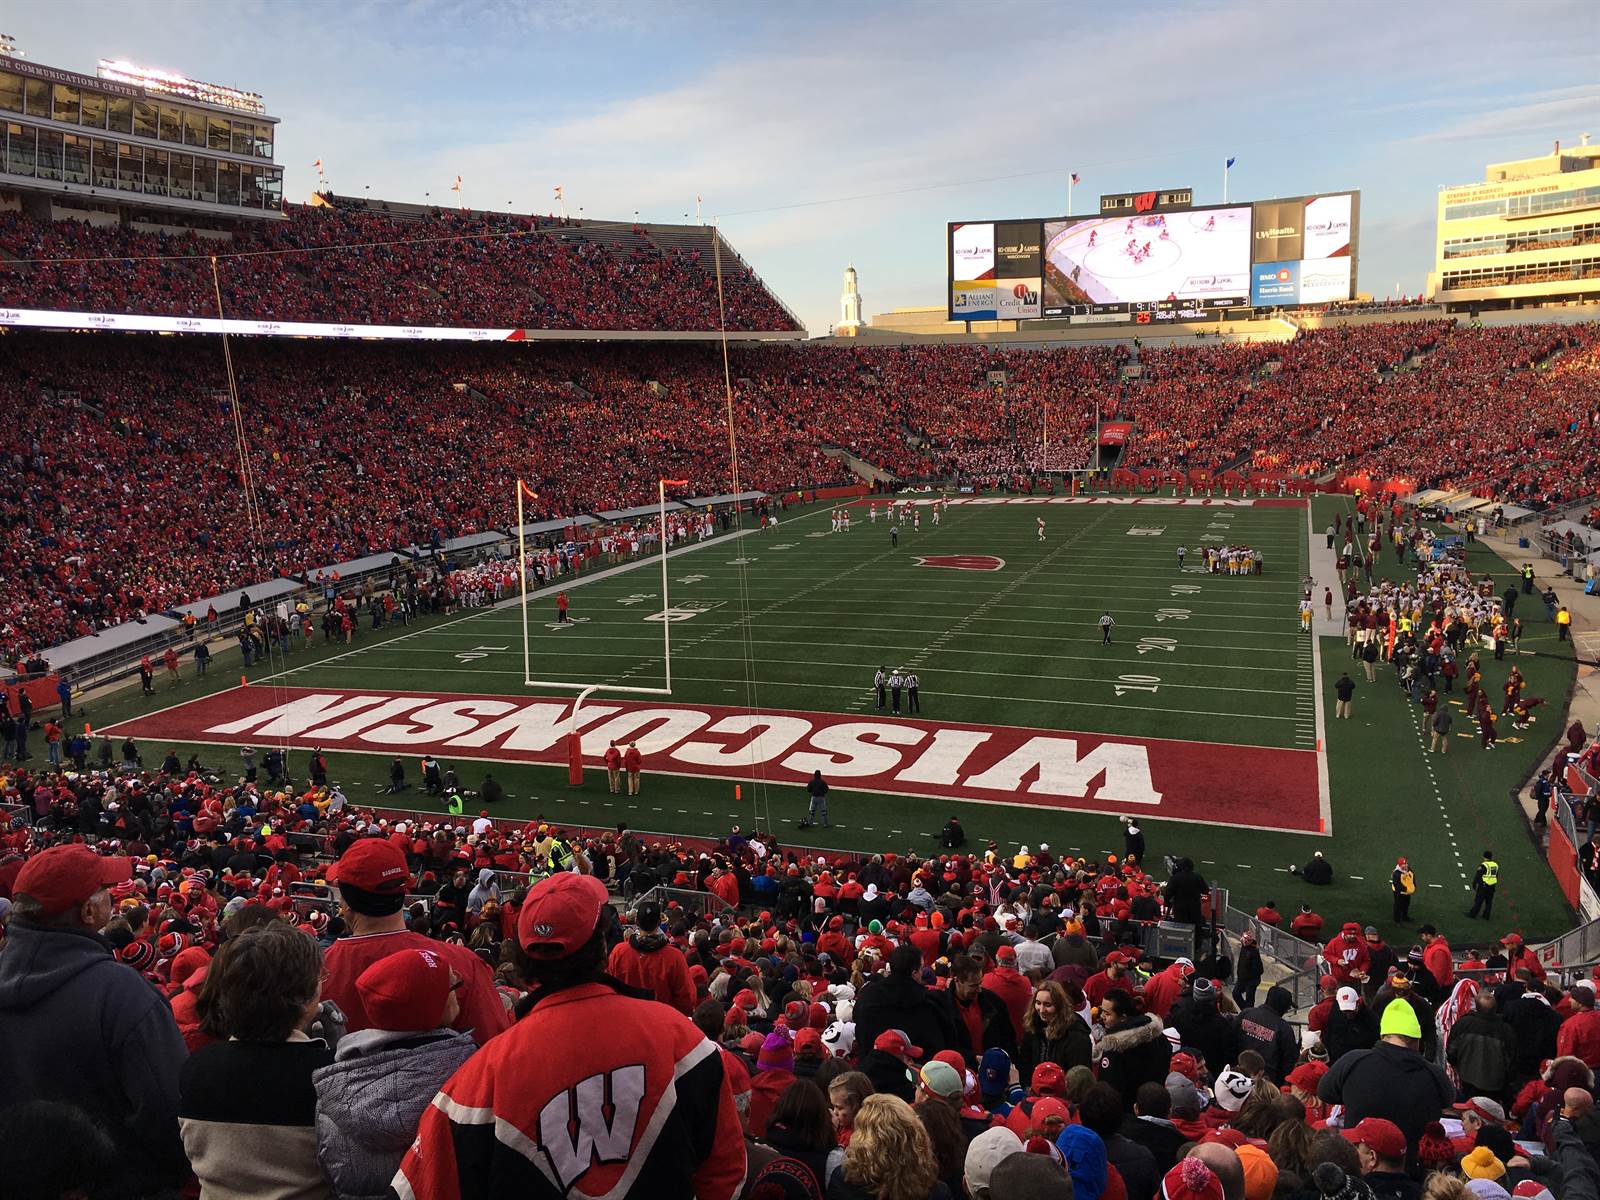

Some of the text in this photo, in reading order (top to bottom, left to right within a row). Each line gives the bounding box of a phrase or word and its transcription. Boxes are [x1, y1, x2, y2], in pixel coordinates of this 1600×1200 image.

[14, 63, 99, 89] COMMUNICATIONS
[102, 83, 138, 97] CENTER
[1134, 191, 1157, 214] W
[967, 293, 994, 301] ALLIANT
[1000, 298, 1020, 307] Credit
[1136, 301, 1157, 312] 9:19
[1136, 312, 1150, 322] 25
[1136, 637, 1178, 652] 20
[1114, 674, 1161, 694] 10
[203, 693, 1164, 807] WISCONSIN
[539, 1063, 647, 1194] W
